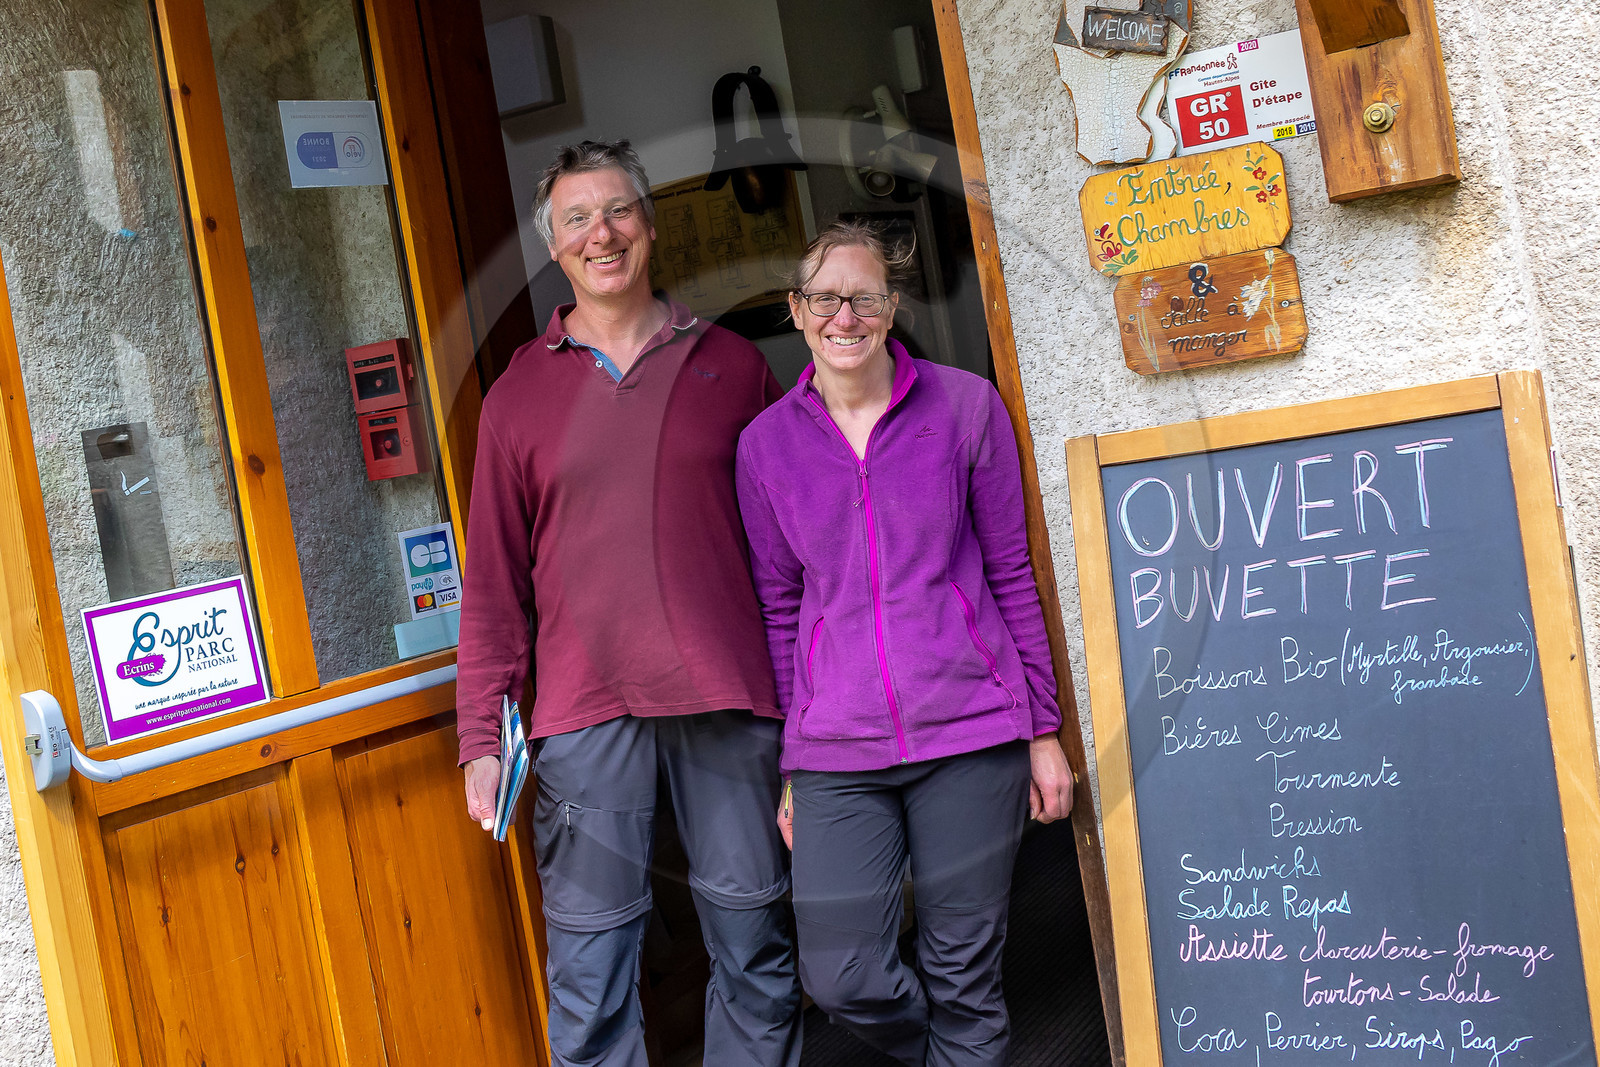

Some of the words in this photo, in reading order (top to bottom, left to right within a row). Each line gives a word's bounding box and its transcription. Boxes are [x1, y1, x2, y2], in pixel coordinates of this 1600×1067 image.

[1085, 14, 1167, 47] WELCOME
[1239, 41, 1257, 51] 2020
[1203, 75, 1240, 87] Hautes-Alpes
[1249, 78, 1277, 92] Gîte
[1252, 90, 1303, 108] D'étape
[1199, 118, 1230, 140] 50
[1256, 120, 1283, 130] Membre
[1276, 127, 1293, 138] 2018
[1298, 121, 1316, 134] 2019
[1116, 197, 1250, 247] Chambres
[1187, 263, 1219, 298] &
[1167, 328, 1249, 357] manger
[1116, 437, 1454, 557] OUVERT
[439, 592, 457, 603] VISA
[1129, 548, 1437, 630] BUVETTE
[184, 637, 235, 663] PARC
[188, 655, 238, 673] NATIONAL
[122, 661, 156, 678] Ecrins
[1152, 646, 1268, 701] Boissons
[134, 701, 146, 711] une
[147, 696, 171, 709] marque
[197, 686, 209, 697] par
[209, 680, 217, 691] la
[217, 677, 238, 688] nature
[146, 696, 232, 725] www.espritparcnational.com
[1256, 750, 1402, 794] Tourmente
[1270, 802, 1363, 839] Pression
[1179, 845, 1322, 886] Sandwichs
[1177, 886, 1271, 921] Salade
[1282, 885, 1352, 932] Repas
[1179, 928, 1289, 963] Assiette
